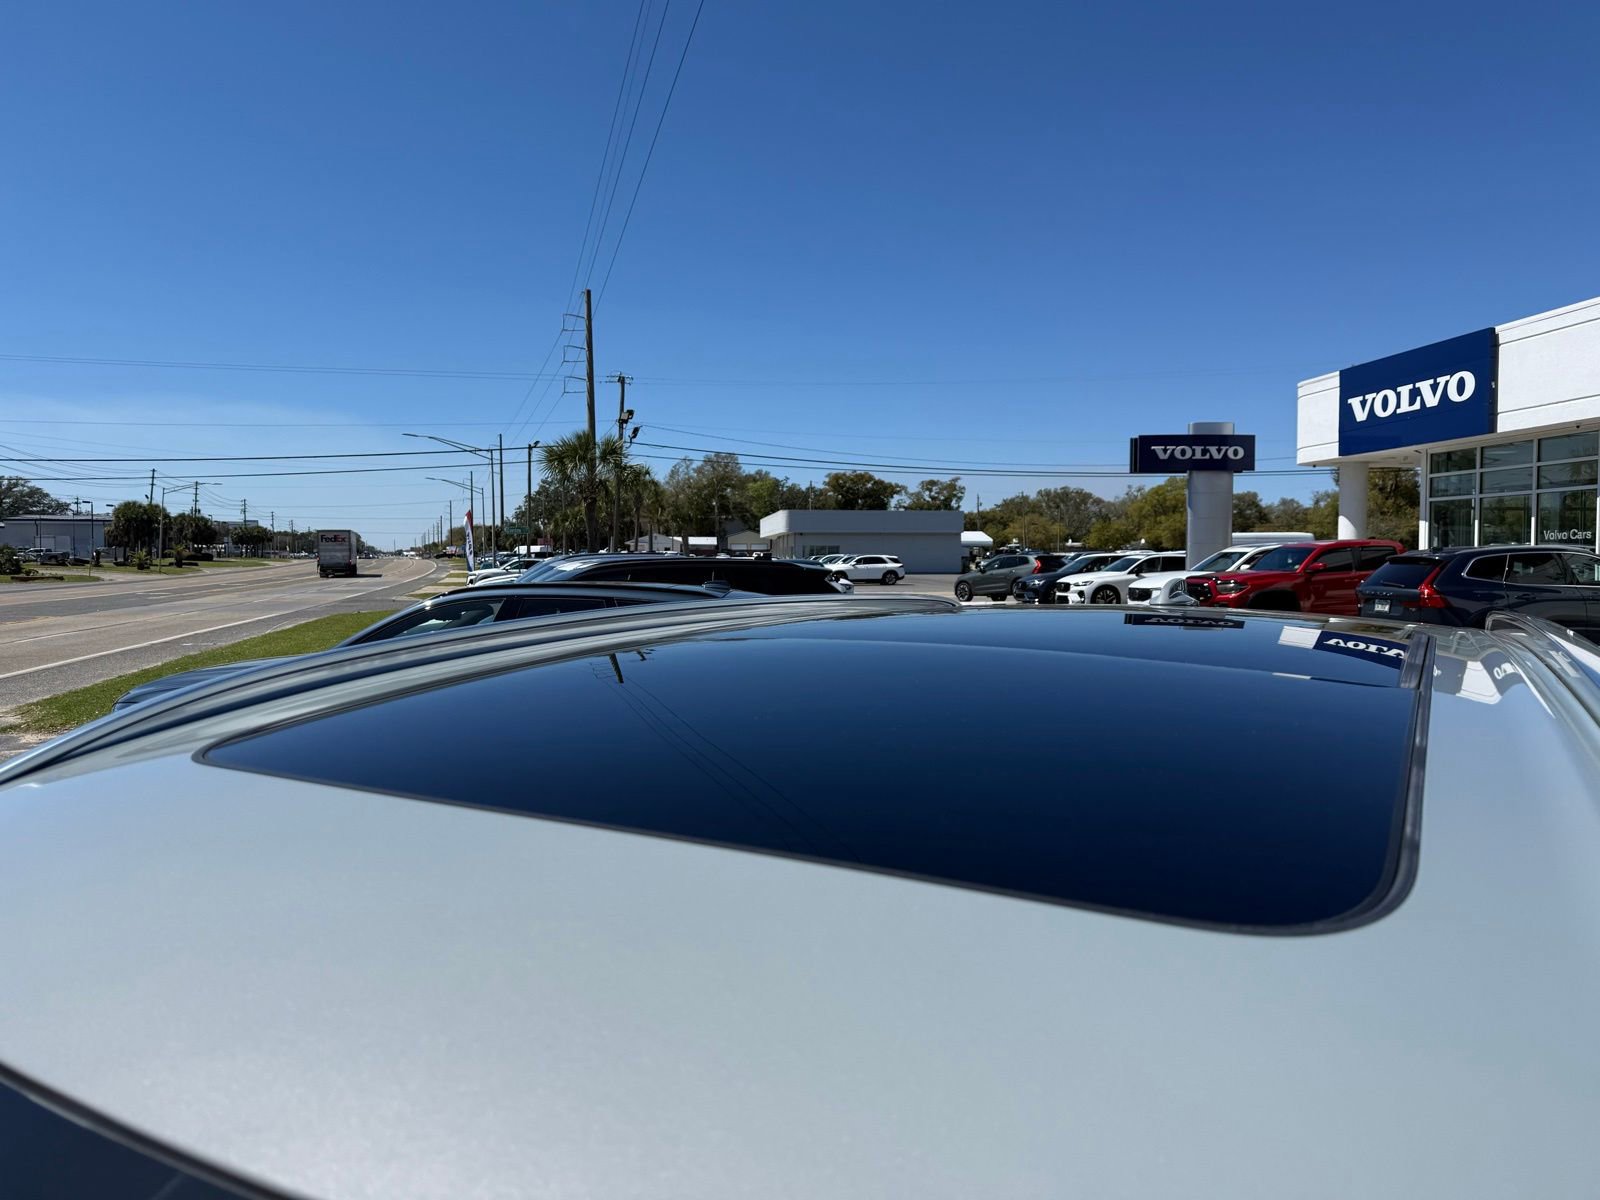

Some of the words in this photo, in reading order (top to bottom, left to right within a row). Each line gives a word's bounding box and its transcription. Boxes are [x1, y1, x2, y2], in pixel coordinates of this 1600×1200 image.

[1347, 370, 1476, 423] VOLVO
[1150, 445, 1245, 460] VOLVO
[320, 534, 346, 543] FedEx
[1543, 529, 1568, 541] Volvo
[1569, 528, 1592, 540] Cars
